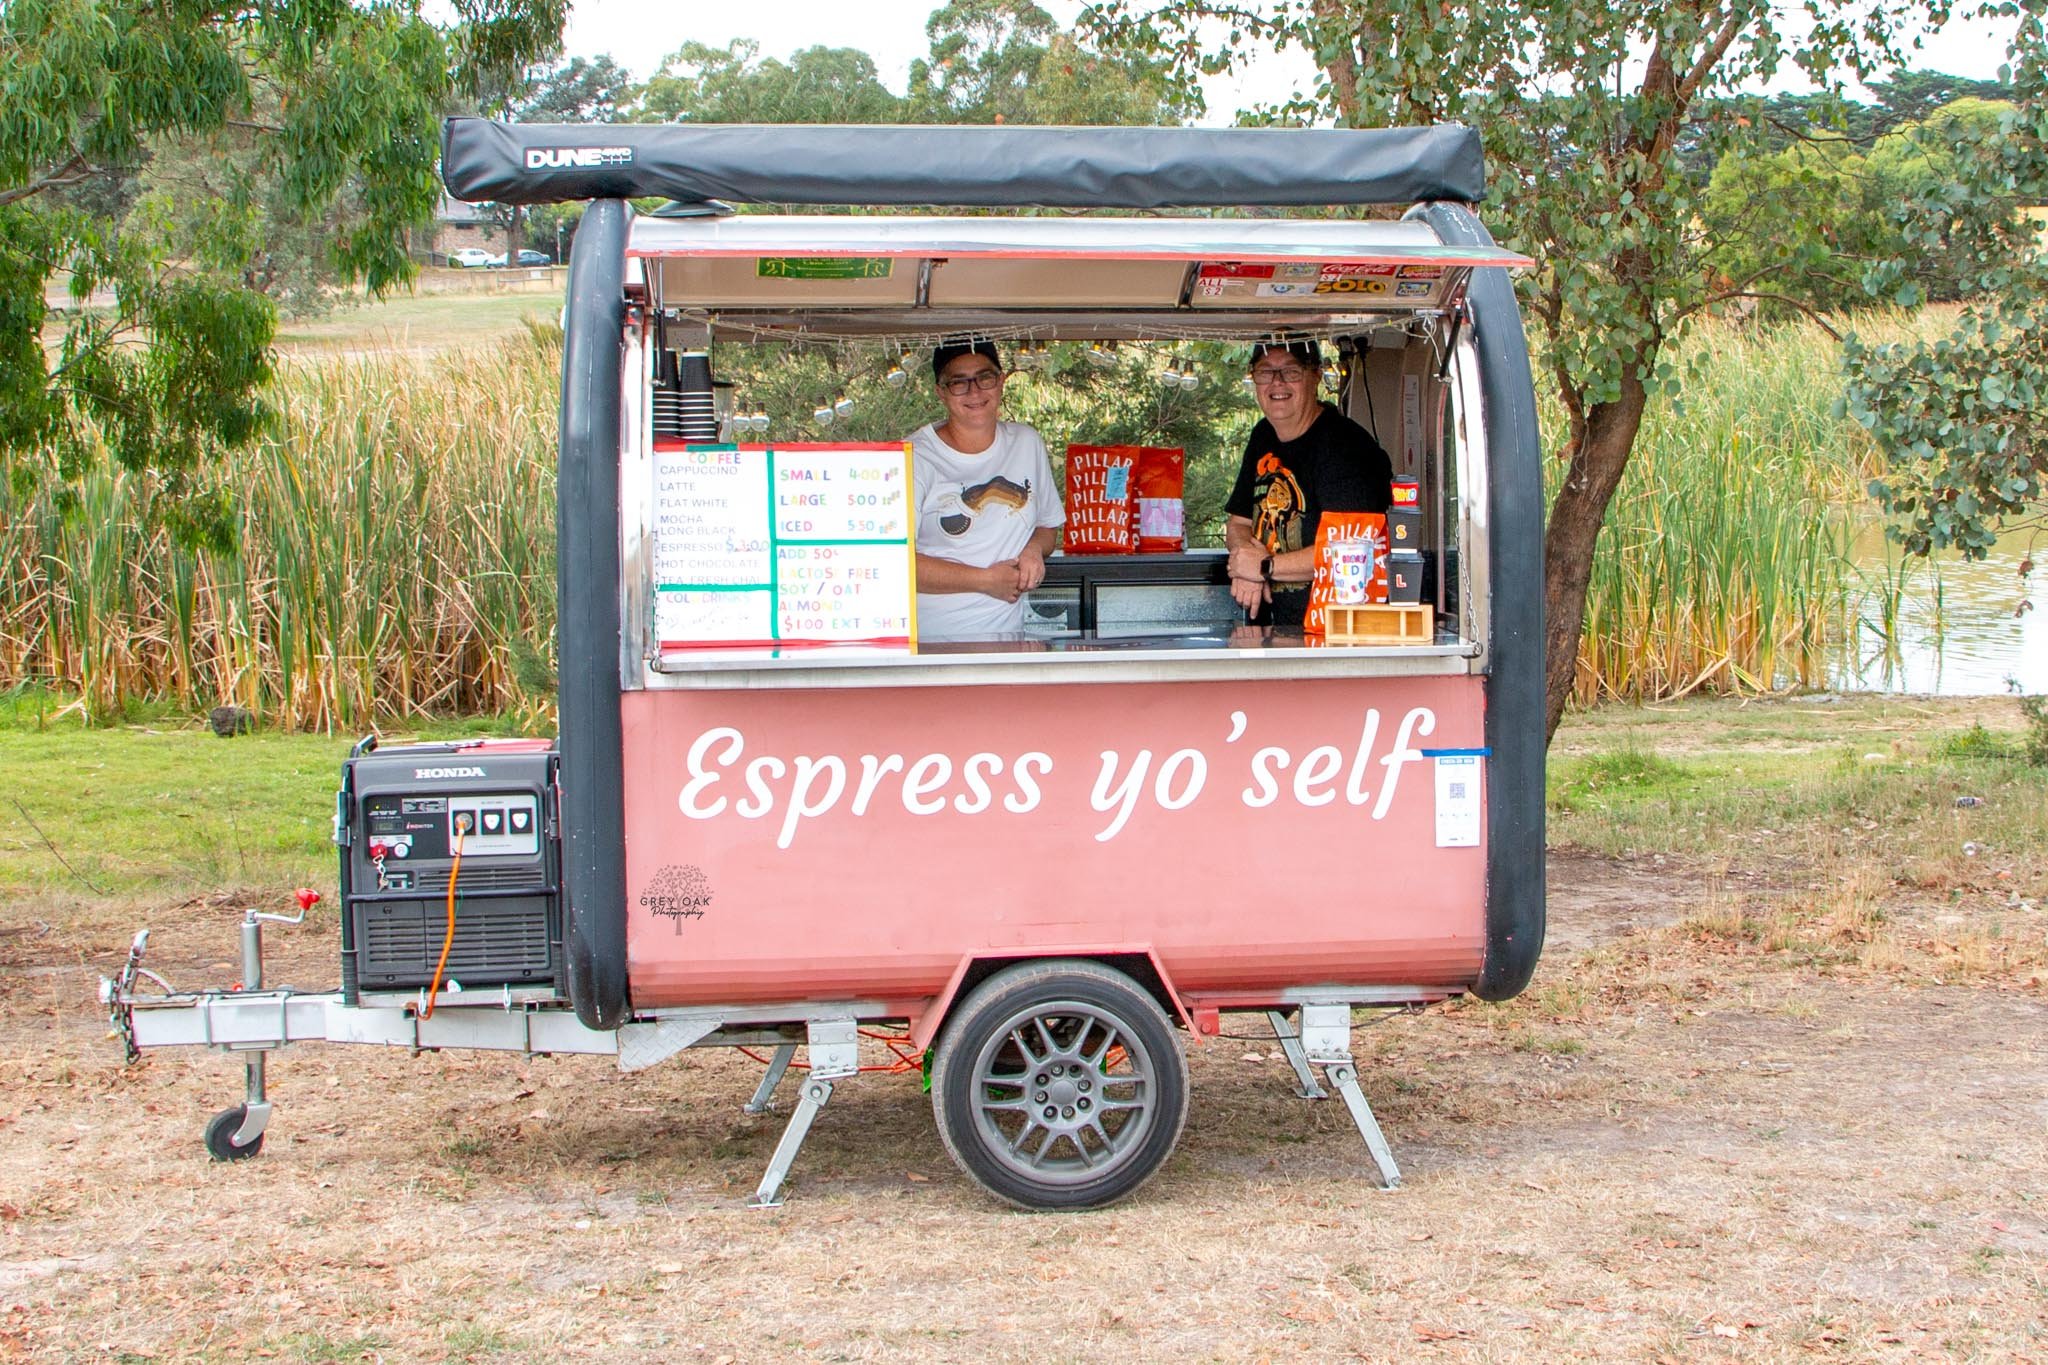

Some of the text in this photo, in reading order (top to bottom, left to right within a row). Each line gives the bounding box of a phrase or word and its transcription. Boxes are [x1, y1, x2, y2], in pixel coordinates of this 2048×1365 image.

[527, 150, 602, 169] DUNE
[1315, 279, 1386, 294] SOLO
[688, 452, 741, 465] COFFEE
[1074, 453, 1133, 471] PILLAR
[660, 465, 738, 476] CAPPUCCINO
[780, 468, 832, 481] SMALL
[660, 482, 696, 492] LATTE
[660, 499, 728, 508] FLAT WHITE
[780, 494, 828, 506] LARGE
[660, 515, 703, 524] MOCHA
[1072, 507, 1129, 527] PILLAR
[660, 526, 736, 536] LONG BLACK
[781, 519, 813, 532] ICED
[1395, 524, 1408, 540] S
[1070, 527, 1129, 546] PILLAR
[661, 543, 724, 553] ESPRESSO
[779, 548, 807, 560] ADD
[661, 560, 760, 569] HOT CHOCOLATE
[780, 567, 880, 580] LACTOSE FREE
[1395, 573, 1407, 589] L
[780, 582, 862, 596] SOY / OAT
[779, 600, 843, 612] ALMOND
[832, 617, 862, 630] EXT
[873, 617, 909, 630] SHOT
[415, 767, 487, 779] HONDA
[679, 727, 1053, 850] Espress
